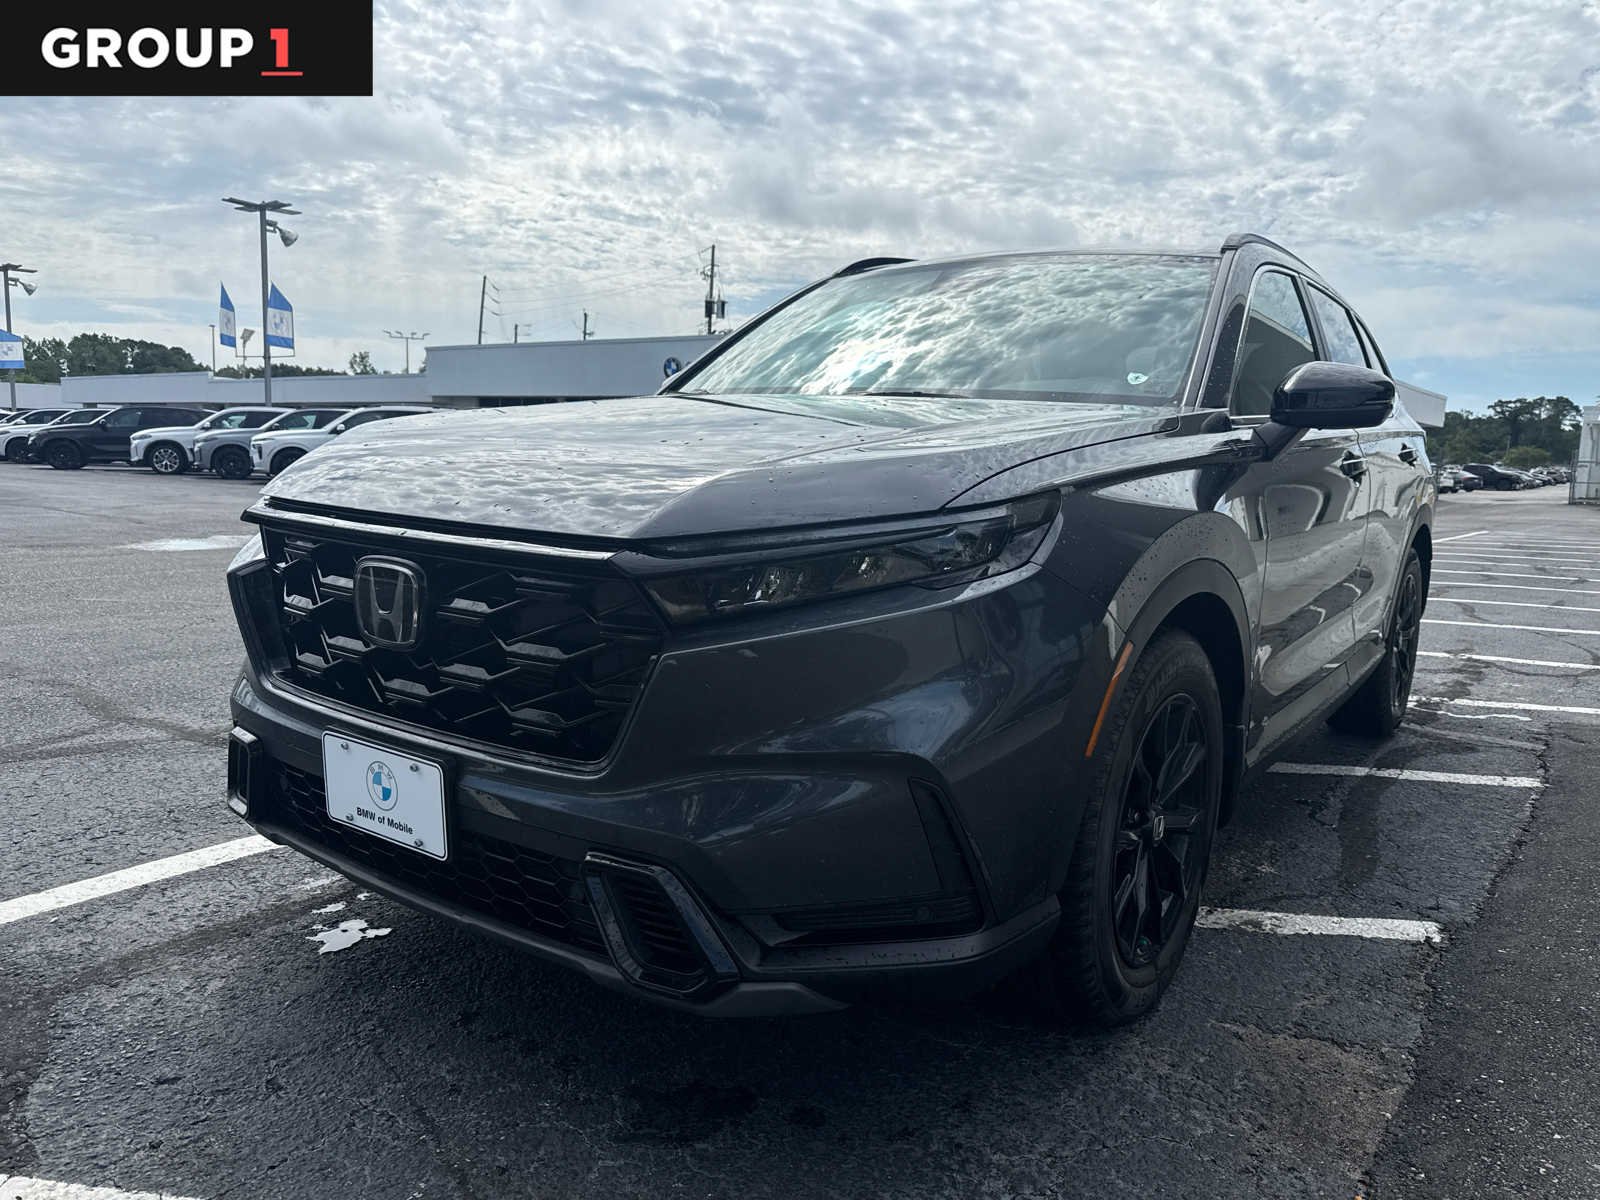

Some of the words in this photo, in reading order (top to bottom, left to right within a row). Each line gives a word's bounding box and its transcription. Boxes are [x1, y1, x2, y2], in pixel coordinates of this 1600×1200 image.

[356, 806, 376, 821] BMW
[377, 816, 386, 825] of
[387, 817, 413, 835] Mobile
